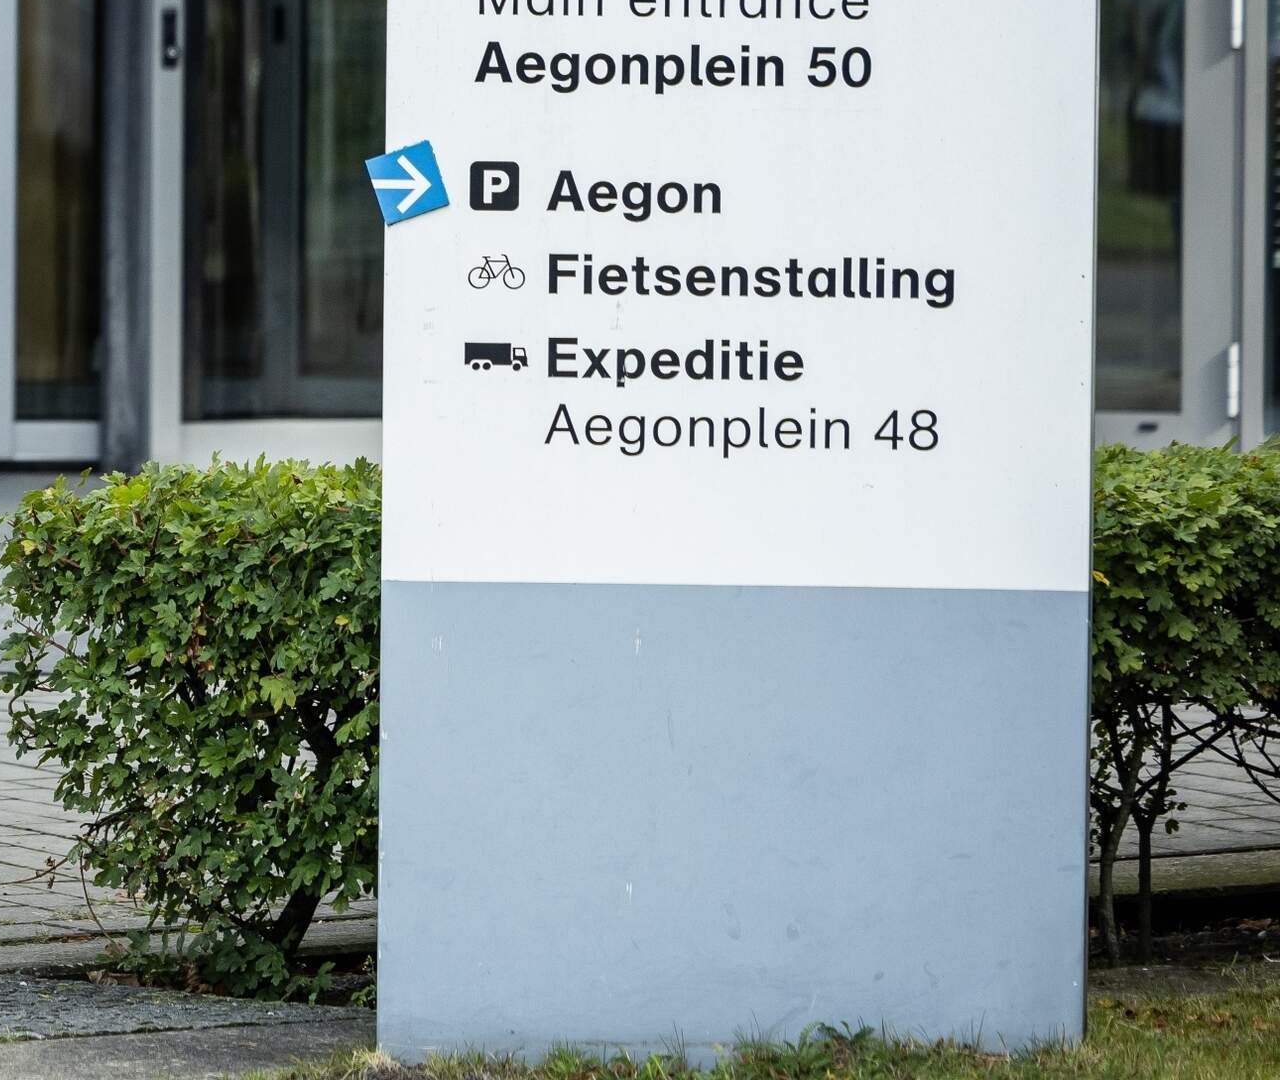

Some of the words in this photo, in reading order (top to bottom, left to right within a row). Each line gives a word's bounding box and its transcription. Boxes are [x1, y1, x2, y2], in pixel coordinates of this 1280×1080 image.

[474, 40, 785, 95] Aegonplein
[806, 45, 873, 89] 50
[546, 169, 722, 223] Aegon
[547, 253, 956, 309] Fietsenstalling
[547, 336, 805, 388] Expeditie
[544, 402, 851, 459] Aegonplein
[873, 409, 940, 451] 48
